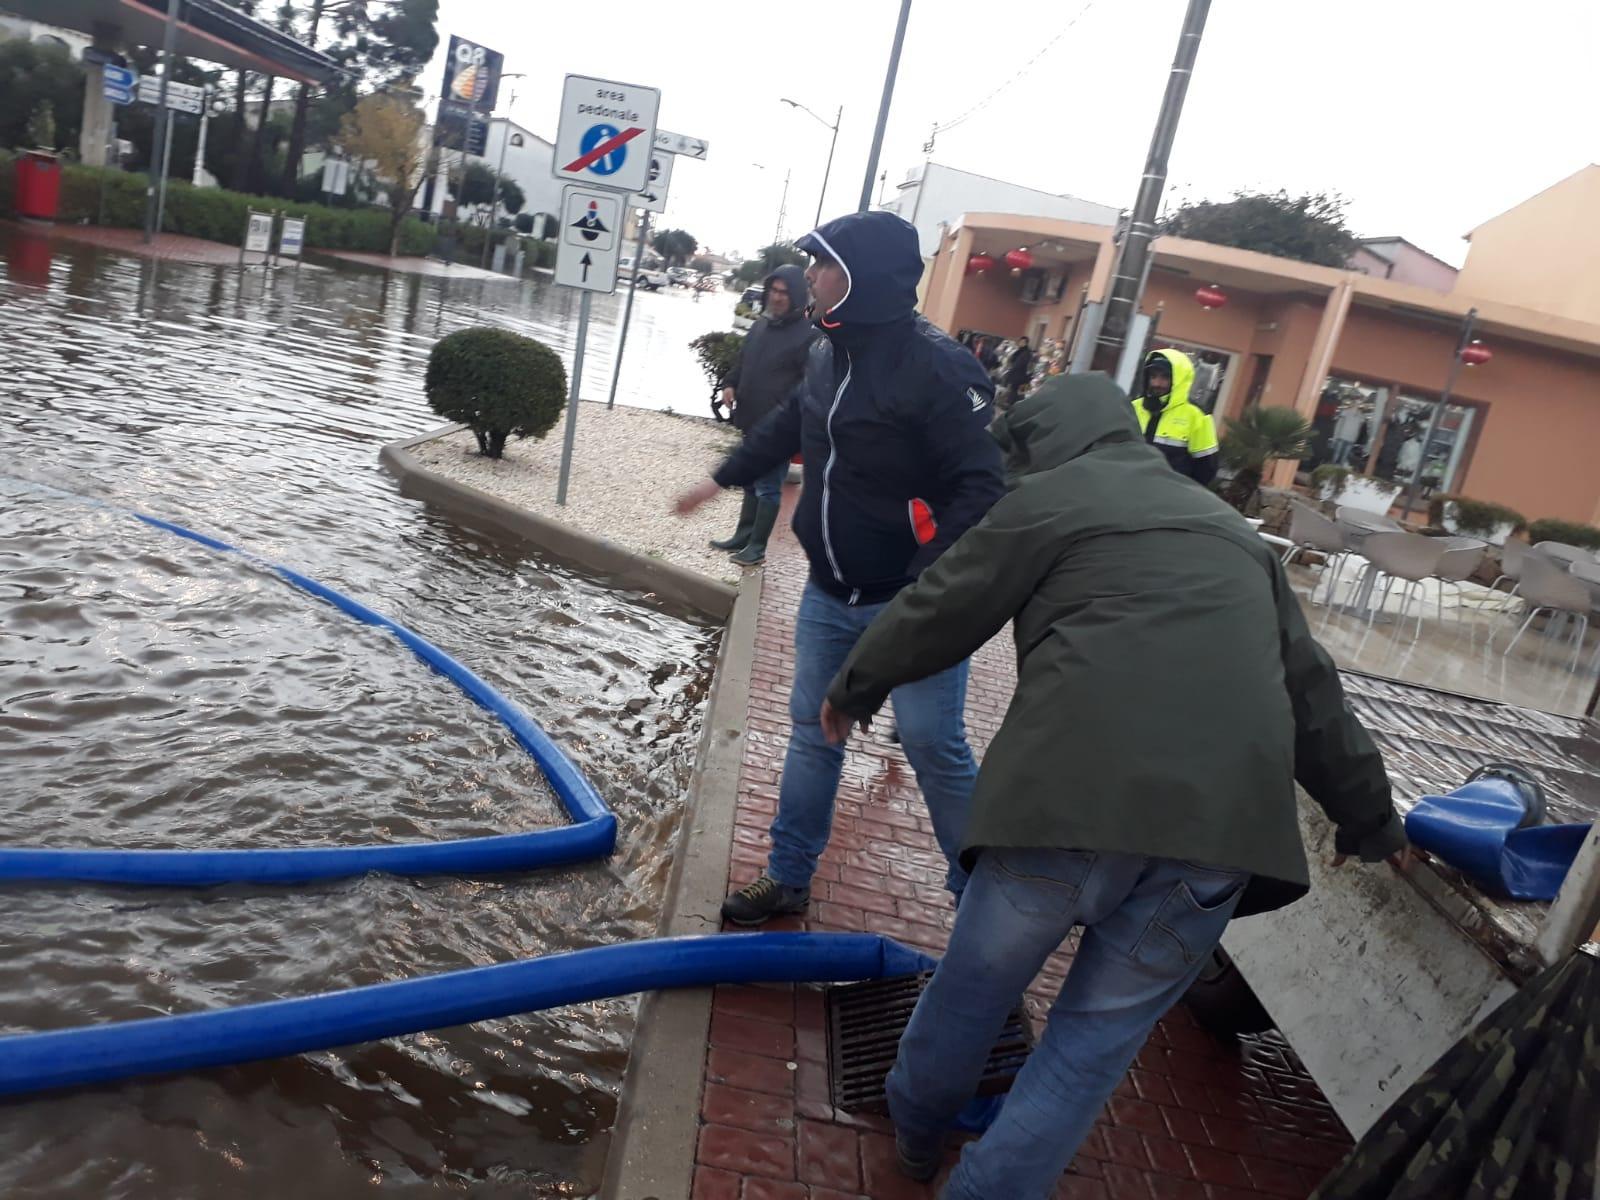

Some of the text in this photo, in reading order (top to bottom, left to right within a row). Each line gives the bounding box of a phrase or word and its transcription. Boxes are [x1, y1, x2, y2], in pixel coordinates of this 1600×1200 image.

[455, 43, 487, 66] Q8
[596, 88, 626, 101] area
[577, 103, 640, 122] pedonale
